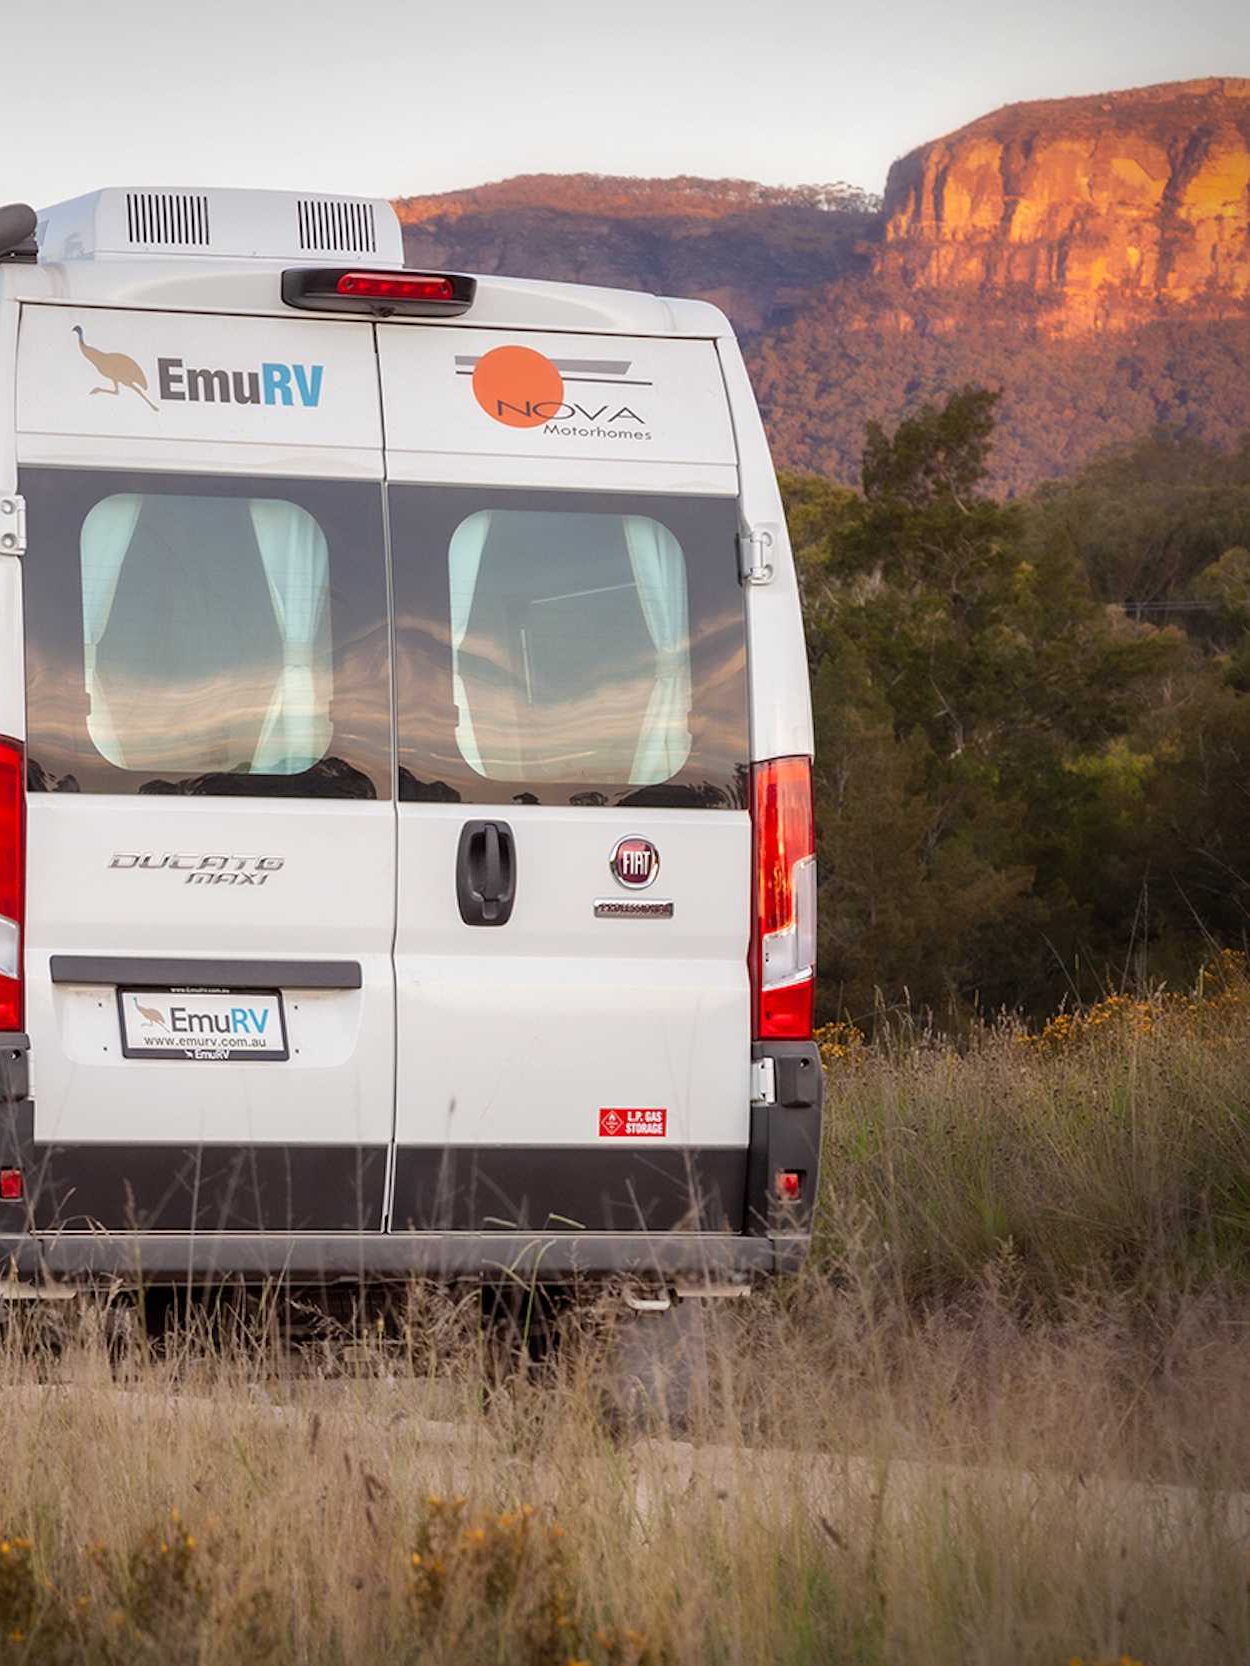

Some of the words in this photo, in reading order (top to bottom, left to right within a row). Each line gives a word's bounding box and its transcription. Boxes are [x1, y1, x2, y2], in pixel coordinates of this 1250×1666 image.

[157, 357, 324, 408] EmuRV
[497, 399, 646, 425] NOVA
[543, 424, 652, 441] Motorhomes
[107, 853, 285, 871] DUCATO
[622, 850, 651, 875] FIAT
[184, 872, 269, 885] MAXI
[170, 1007, 269, 1034] EmuRV
[144, 1035, 267, 1048] www.emurv.com.au
[644, 1111, 662, 1122] GAS
[625, 1122, 663, 1134] STORAGE
